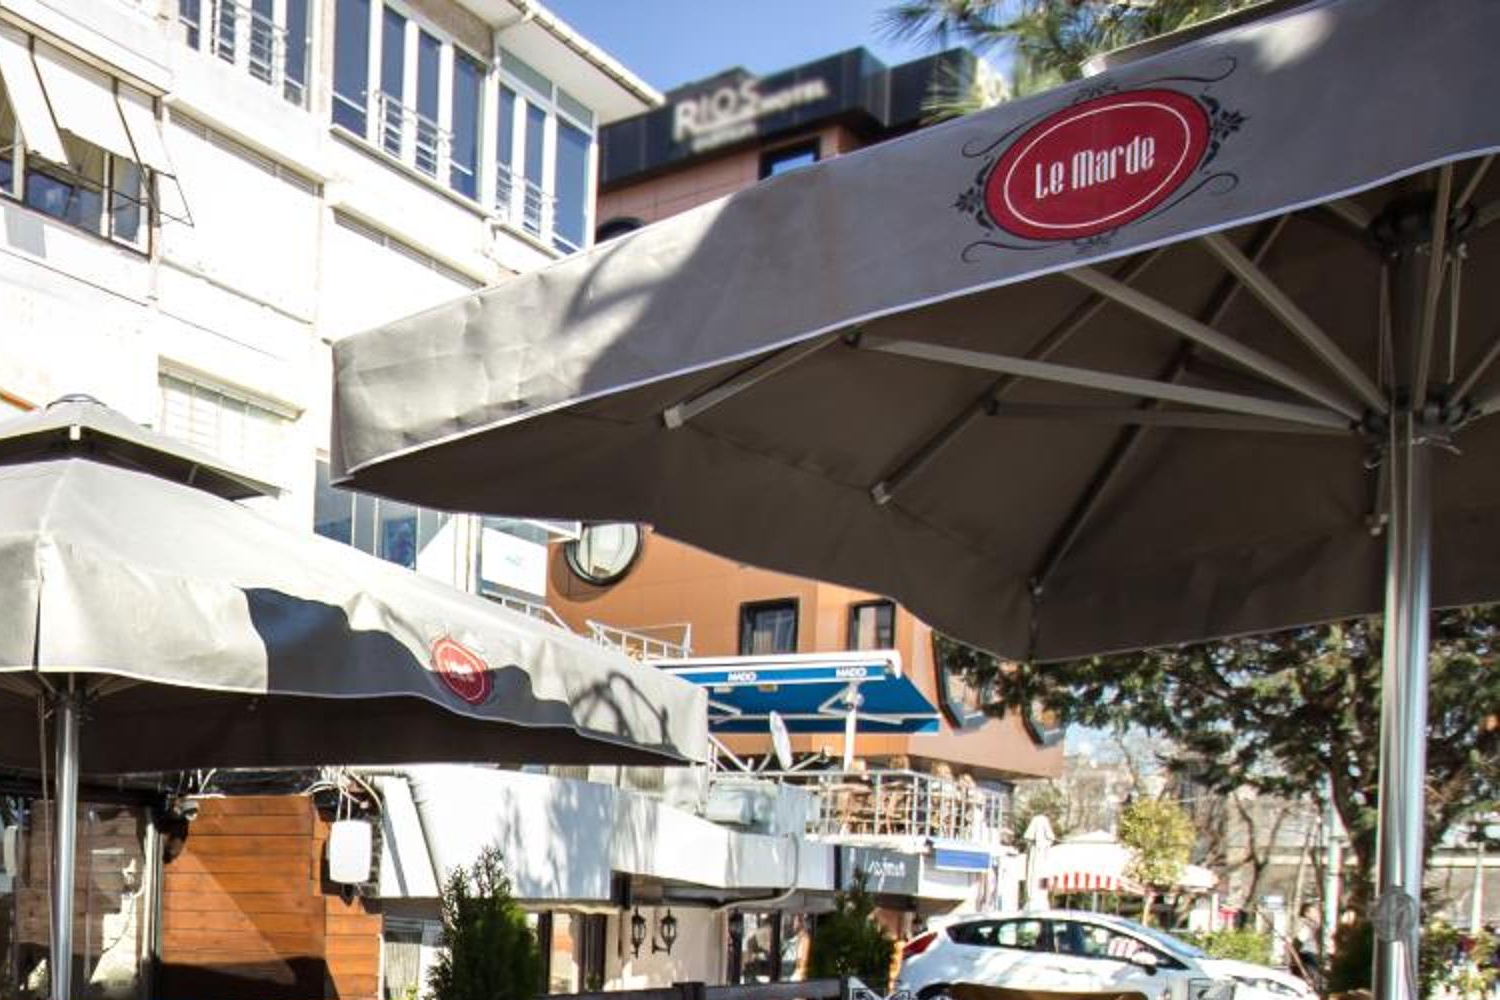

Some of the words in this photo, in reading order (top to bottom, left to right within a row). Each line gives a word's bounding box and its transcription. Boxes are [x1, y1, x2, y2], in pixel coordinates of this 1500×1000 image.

[673, 79, 758, 142] RIOS
[1034, 161, 1065, 199] Le
[1071, 135, 1156, 190] Marde
